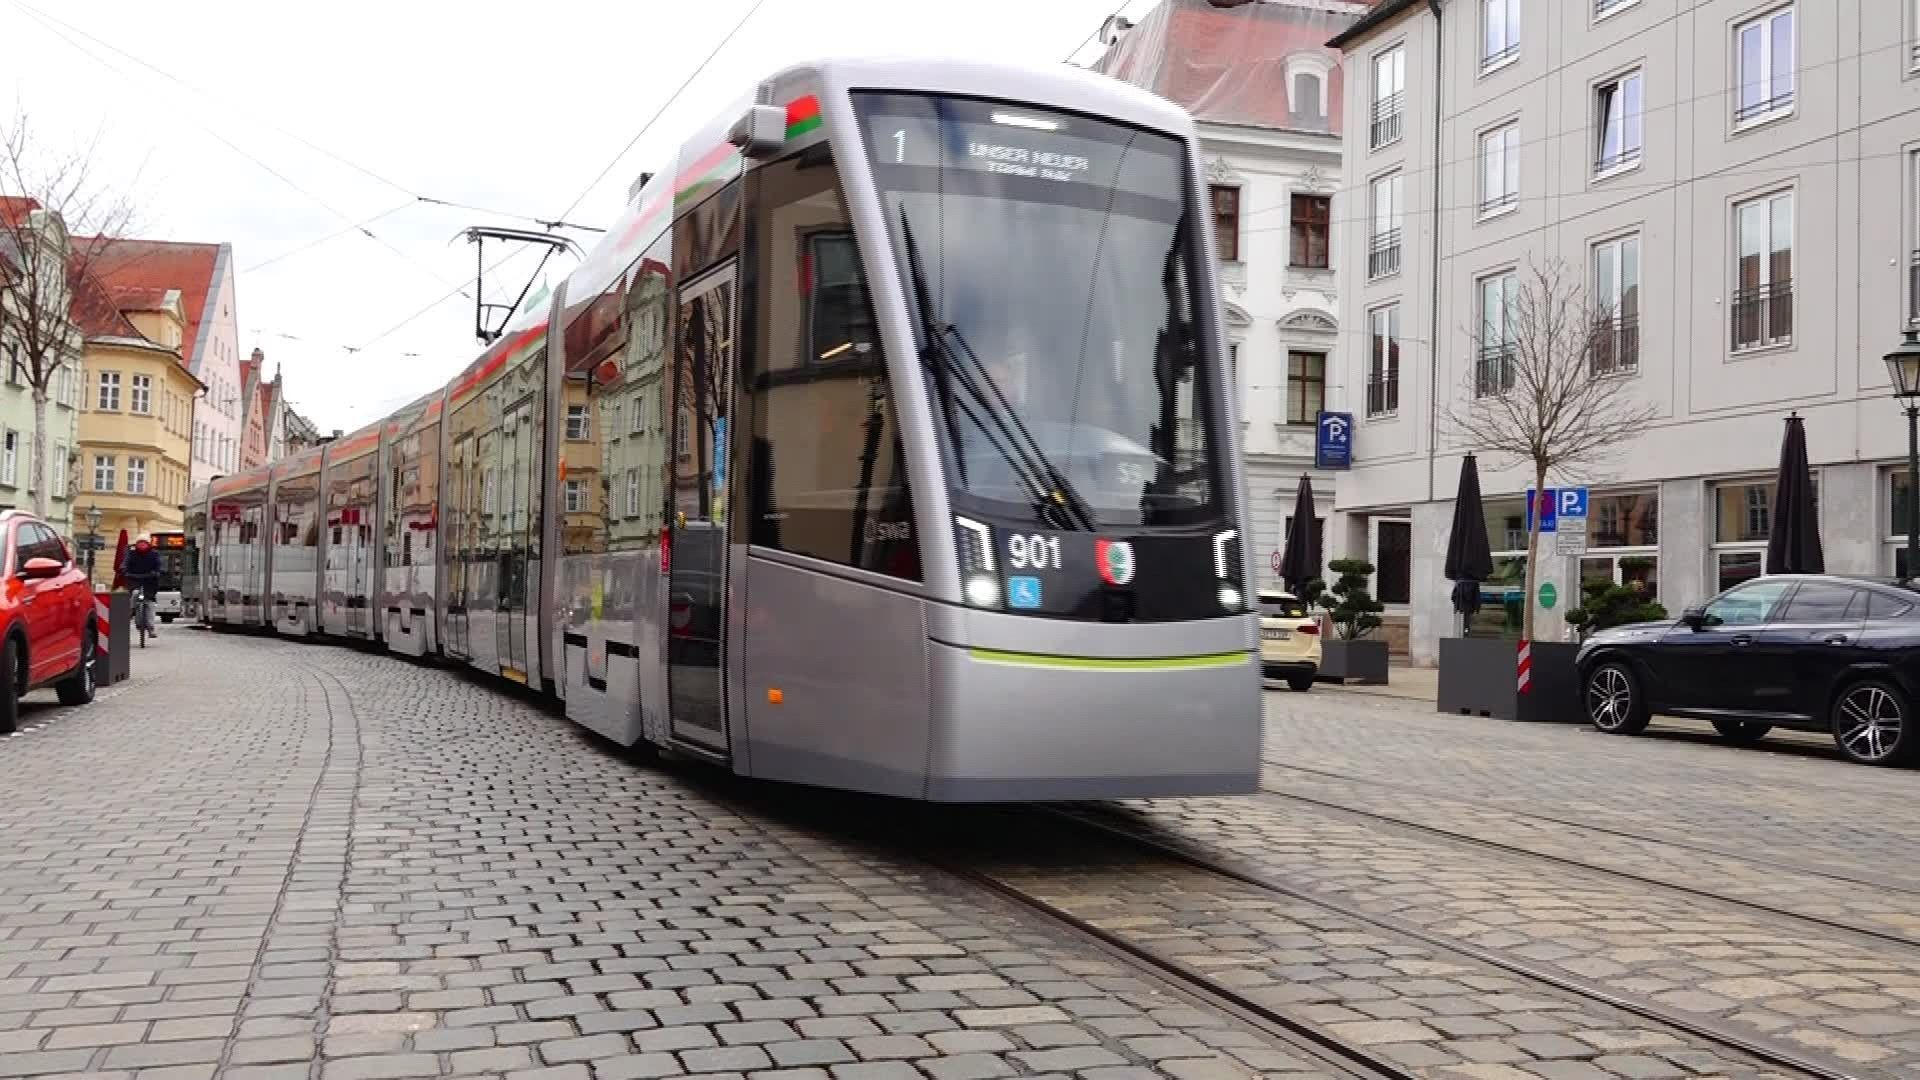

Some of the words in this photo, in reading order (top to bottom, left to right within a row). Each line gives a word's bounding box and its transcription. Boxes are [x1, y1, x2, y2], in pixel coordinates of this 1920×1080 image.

[892, 130, 905, 162] 1
[968, 143, 1029, 164] UNSER
[1031, 151, 1089, 172] NEUER
[1561, 492, 1579, 513] P
[1007, 533, 1062, 569] 901
